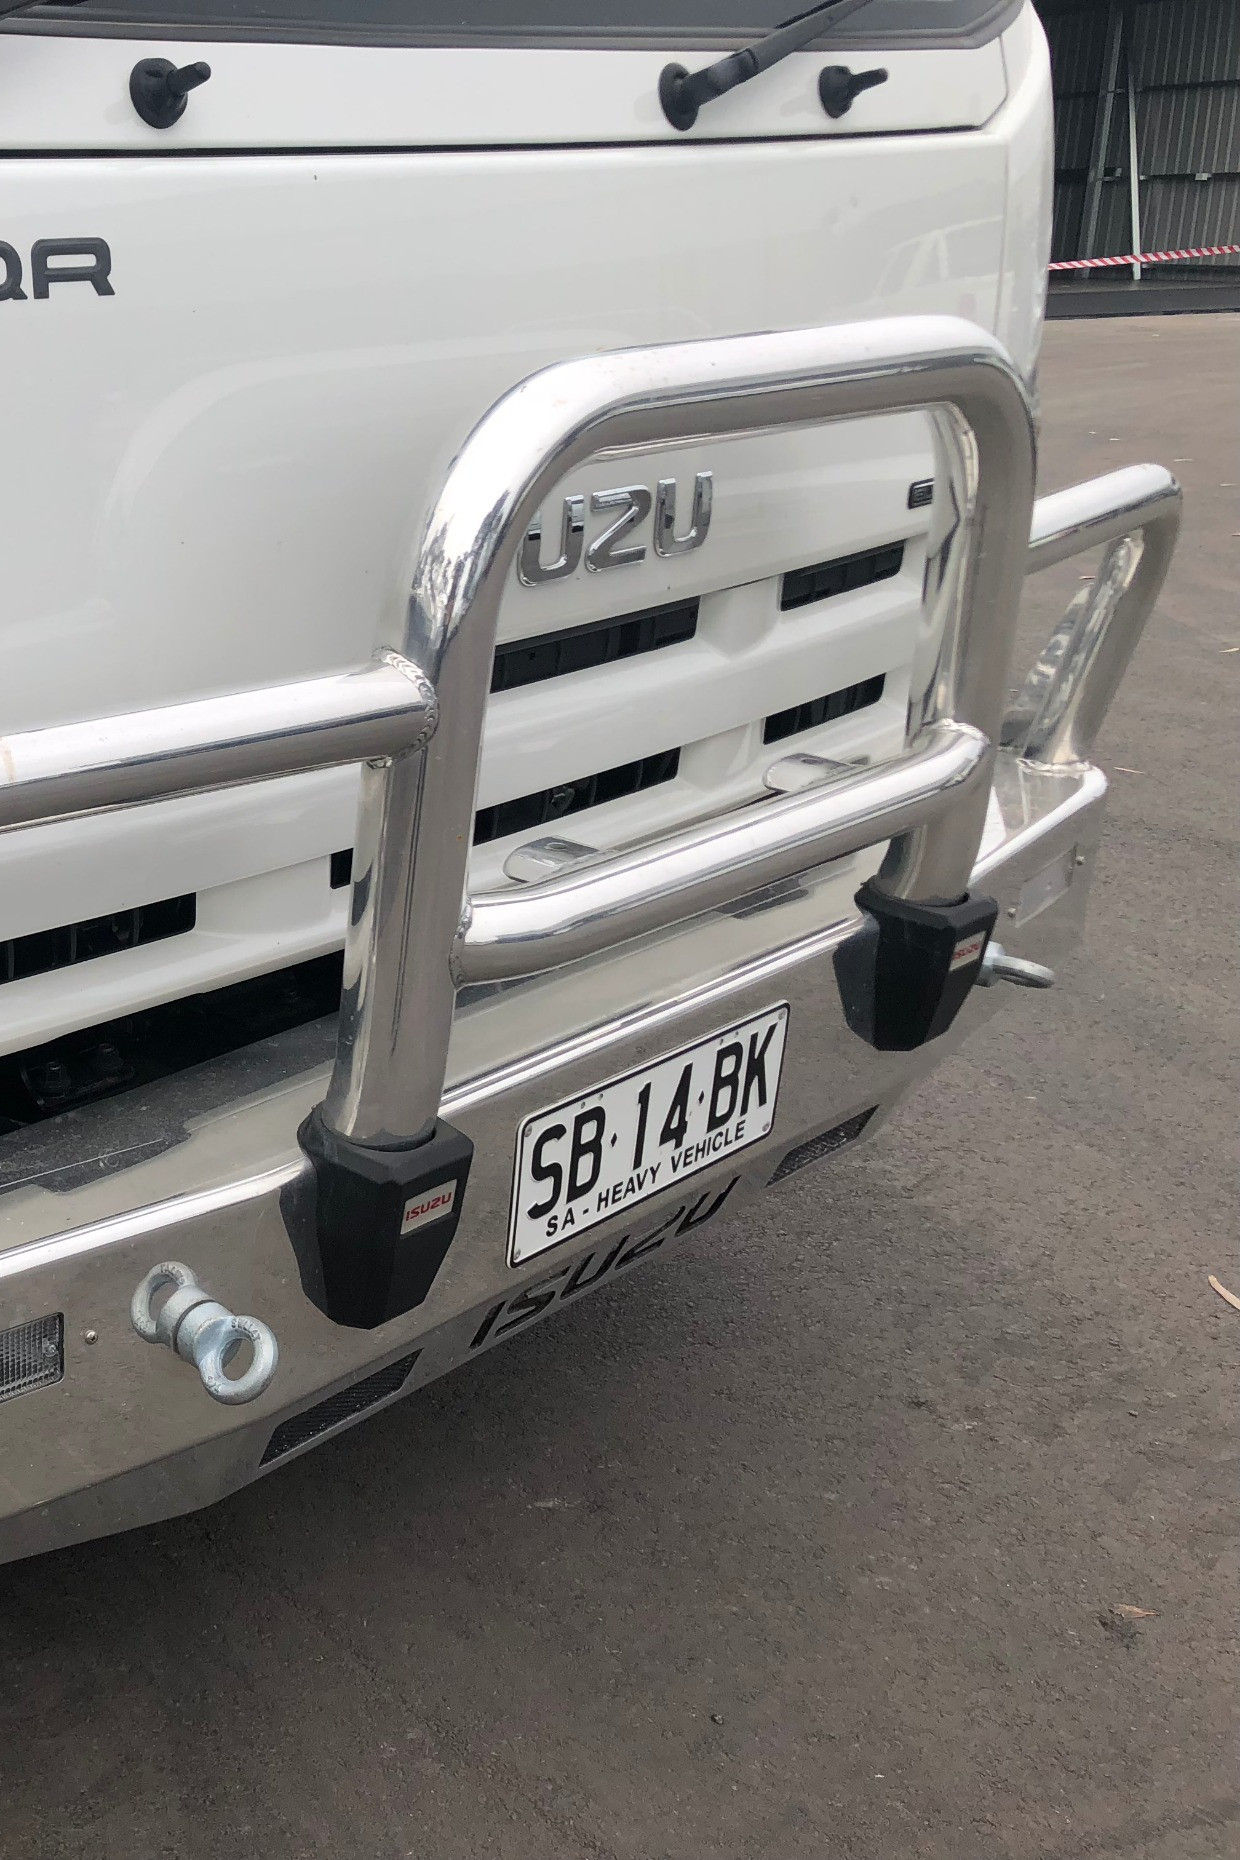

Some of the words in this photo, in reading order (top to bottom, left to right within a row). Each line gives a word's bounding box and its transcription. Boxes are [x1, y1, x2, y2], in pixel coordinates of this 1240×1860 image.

[517, 470, 714, 587] UZU
[405, 1191, 452, 1222] ISUZU
[596, 1162, 662, 1213] HEAVY
[671, 1119, 746, 1173] VEHICLE
